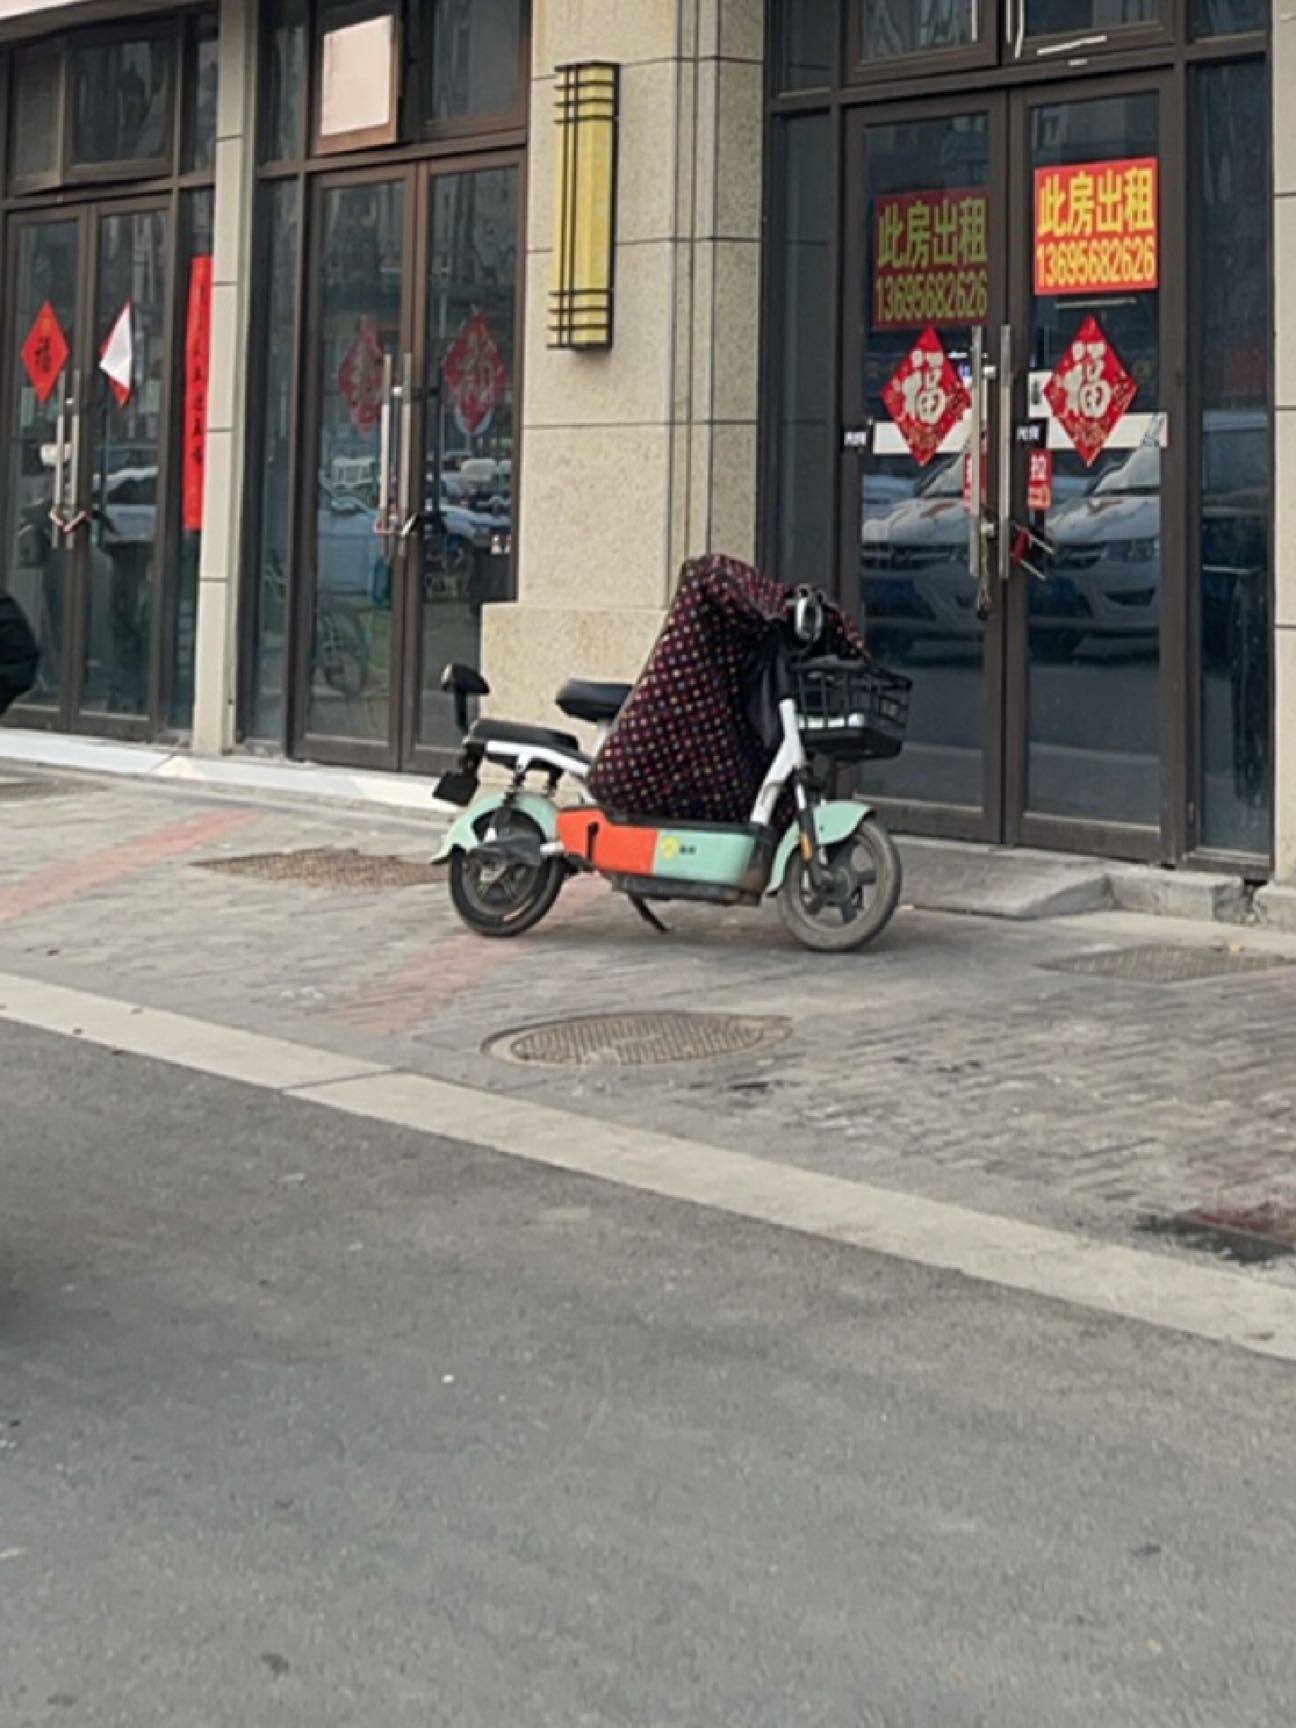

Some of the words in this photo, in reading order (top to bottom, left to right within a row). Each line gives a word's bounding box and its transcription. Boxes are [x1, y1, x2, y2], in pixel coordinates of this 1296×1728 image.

[877, 195, 988, 269] 此房出租
[1037, 166, 1155, 238] 此房出租
[1036, 235, 1155, 287] 13695682626
[902, 349, 946, 425] 福
[1063, 341, 1112, 418] 福
